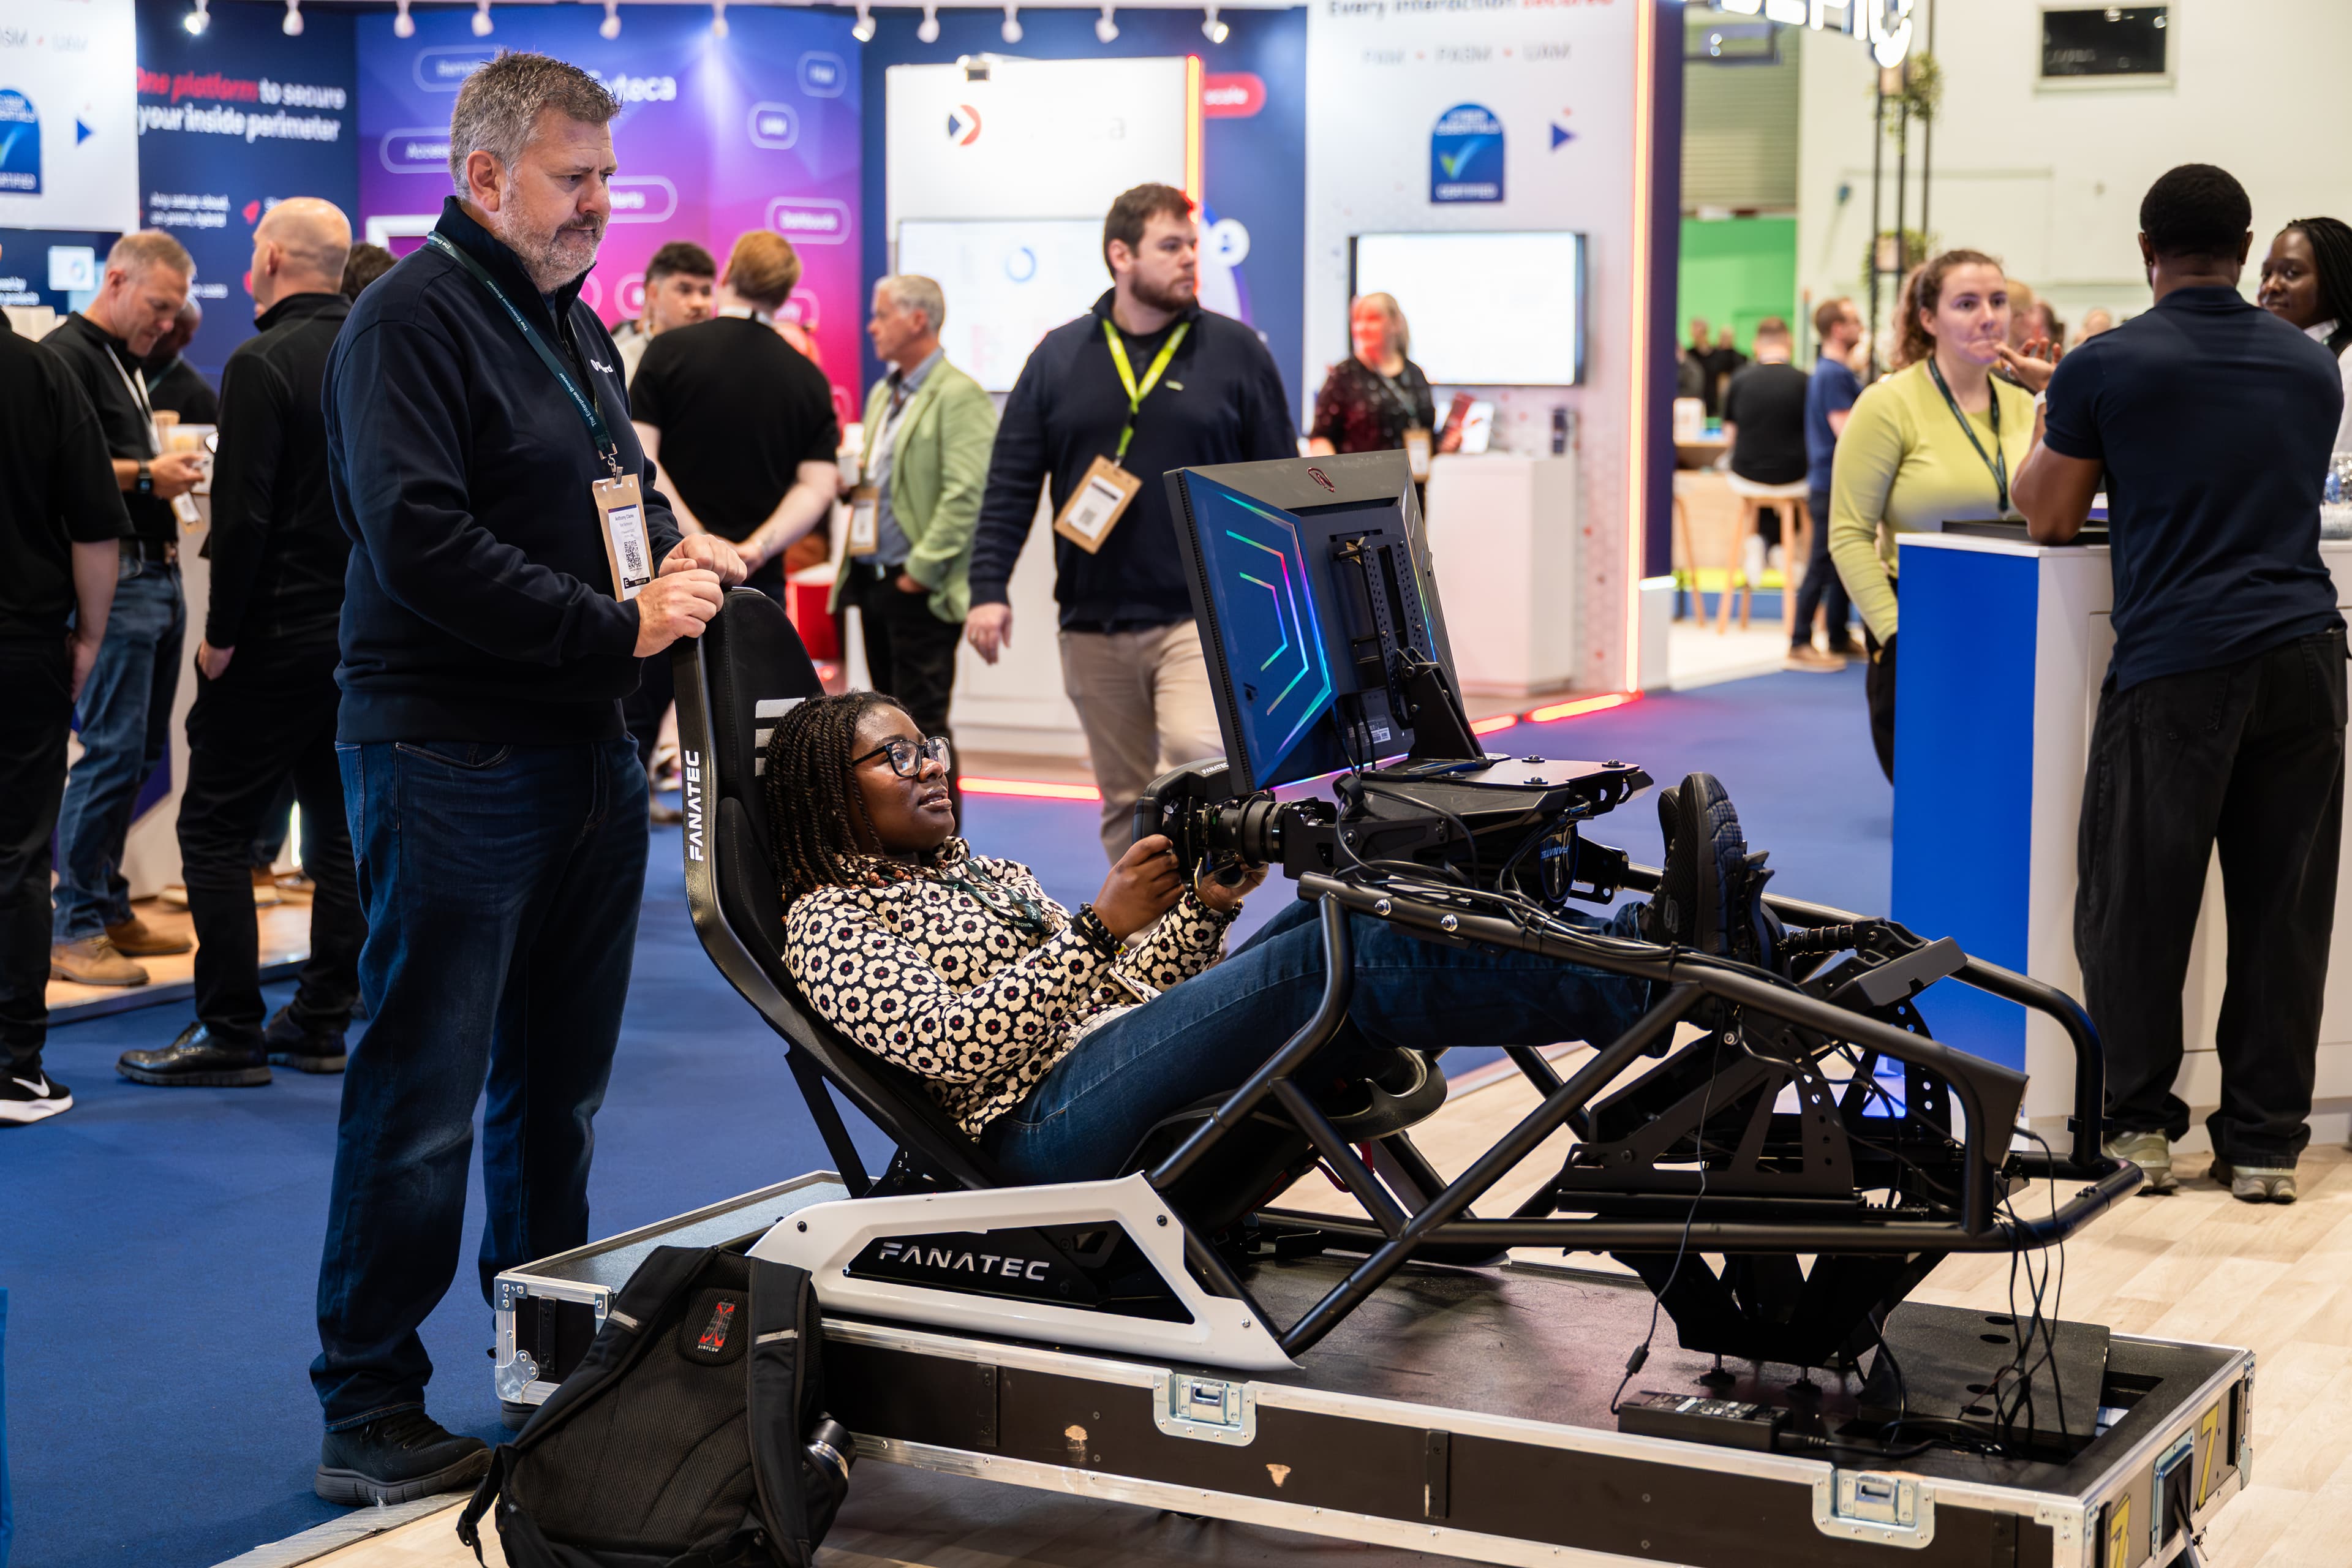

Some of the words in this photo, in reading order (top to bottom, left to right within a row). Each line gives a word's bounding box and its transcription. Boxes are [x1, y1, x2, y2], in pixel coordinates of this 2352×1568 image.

[170, 70, 260, 104] platform
[258, 77, 282, 105] to
[282, 83, 347, 110] secure
[138, 104, 184, 135] your
[184, 102, 246, 135] inside
[246, 109, 341, 143] perimeter
[442, 241, 451, 250] The
[486, 281, 503, 299] Browser
[502, 298, 522, 322] Enterprise
[559, 372, 575, 393] Browser
[573, 391, 592, 418] Enterprise
[685, 750, 704, 861] FANATEC
[879, 1242, 1050, 1281] FANATEC
